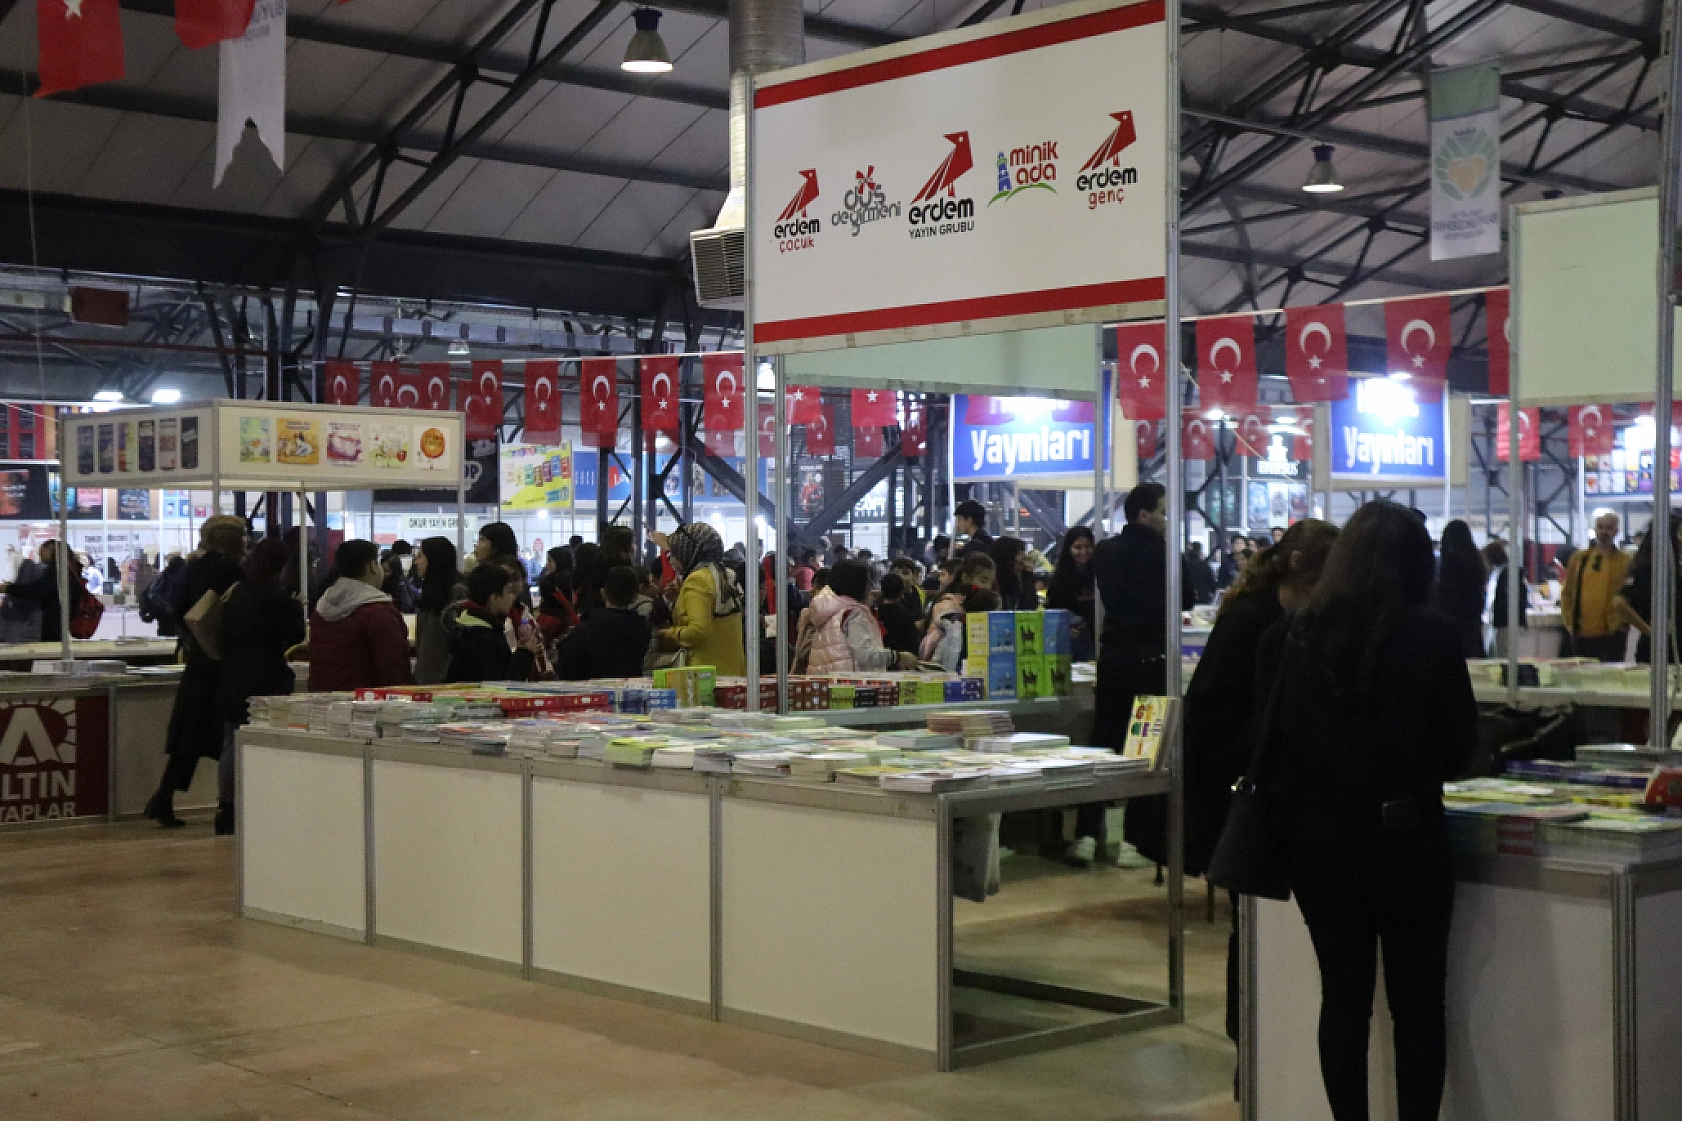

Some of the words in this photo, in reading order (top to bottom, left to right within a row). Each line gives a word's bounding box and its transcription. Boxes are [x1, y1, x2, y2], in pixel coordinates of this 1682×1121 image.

[1010, 141, 1059, 167] minik
[1016, 163, 1057, 185] ada
[1077, 167, 1138, 191] erdem
[1088, 188, 1125, 210] genç
[908, 198, 975, 225] erdem
[774, 218, 821, 239] erdem
[909, 225, 938, 239] YAYIN
[939, 220, 975, 235] GRUBU
